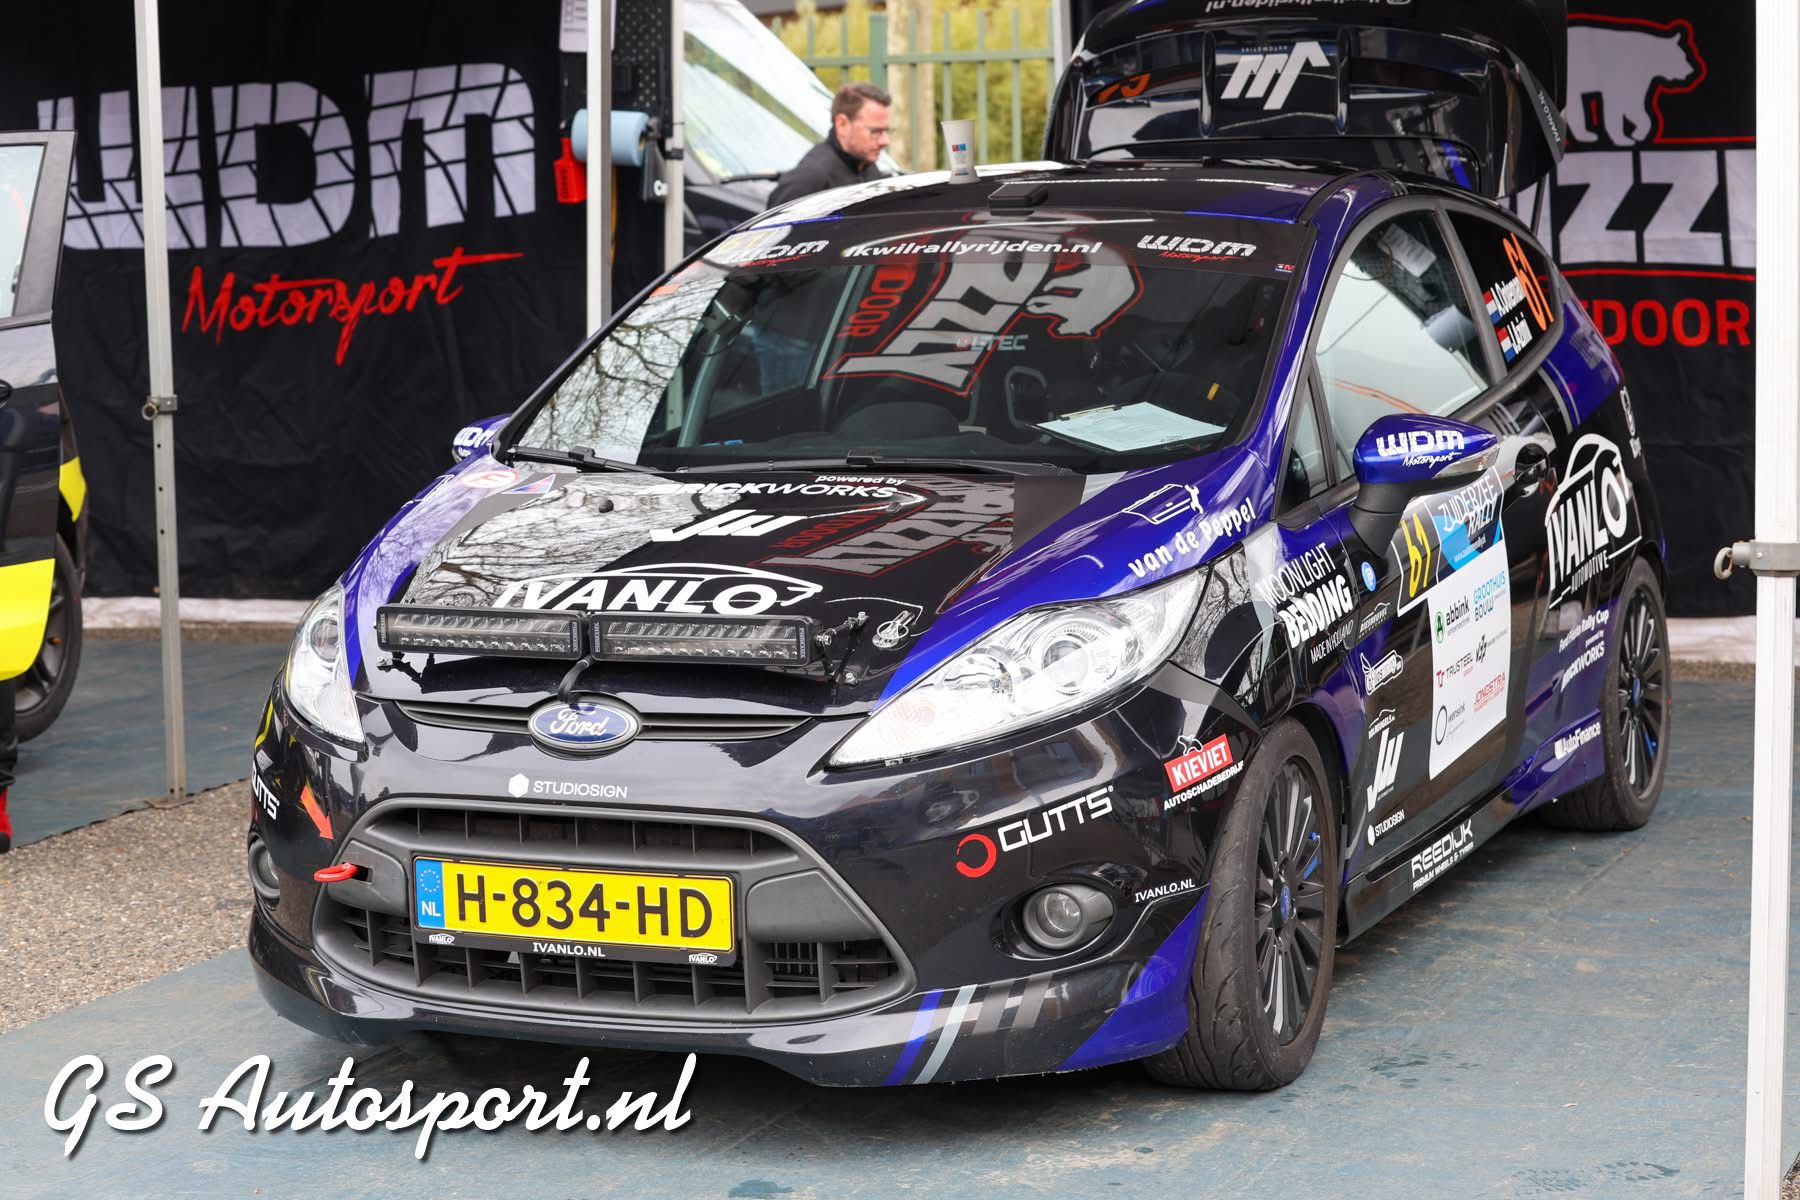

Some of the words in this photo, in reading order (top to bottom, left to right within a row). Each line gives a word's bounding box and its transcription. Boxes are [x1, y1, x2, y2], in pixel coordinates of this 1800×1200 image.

[38, 63, 536, 250] WDM
[1137, 234, 1257, 257] WDM
[1503, 231, 1554, 331] 61
[182, 246, 525, 367] Motorsport
[1582, 297, 1752, 347] DOOR
[1376, 430, 1465, 457] WDM
[1402, 451, 1463, 469] Motorsport
[633, 483, 900, 498] BRICKWORKS
[815, 475, 885, 486] powered
[886, 477, 906, 487] by
[1438, 475, 1498, 532] ZUIDERZEE
[1466, 494, 1499, 537] RALLY
[1128, 545, 1174, 578] van
[1174, 532, 1200, 555] de
[1198, 497, 1257, 541] Peppel
[1546, 466, 1628, 592] IVANLO
[1401, 511, 1431, 598] 61
[1570, 549, 1610, 595] AUTOMOTIVE
[1255, 542, 1337, 609] MOONLIGHT
[1473, 570, 1506, 605] GROOTHUIS
[491, 578, 778, 616] IVANLO
[1277, 574, 1354, 649] BEDDING
[1445, 595, 1470, 627] abbink
[1474, 594, 1494, 622] BOUW
[1581, 614, 1596, 632] Rally
[1595, 608, 1610, 626] Cup
[1310, 641, 1326, 665] MADE
[1329, 618, 1355, 651] HOLLAND
[1446, 652, 1473, 680] TRUSTEEL
[1475, 671, 1506, 703] JONGSTRA
[549, 707, 611, 736] Ford
[1562, 721, 1601, 754] AutoFinance
[1171, 741, 1228, 786] KIEVIET
[533, 780, 628, 799] STUDIOSIGN
[1163, 760, 1244, 811] AUTOSCHADEBEDRIJF
[1374, 808, 1406, 837] STUDIOSIGN
[1411, 818, 1474, 879] REEDIJK
[421, 901, 441, 918] NL
[456, 873, 712, 938] H-834-HD
[1135, 878, 1195, 902] IVANLO.NL
[429, 933, 454, 945] IVANLO
[533, 942, 605, 957] IVANLO.NL
[688, 952, 717, 964] IVANLO
